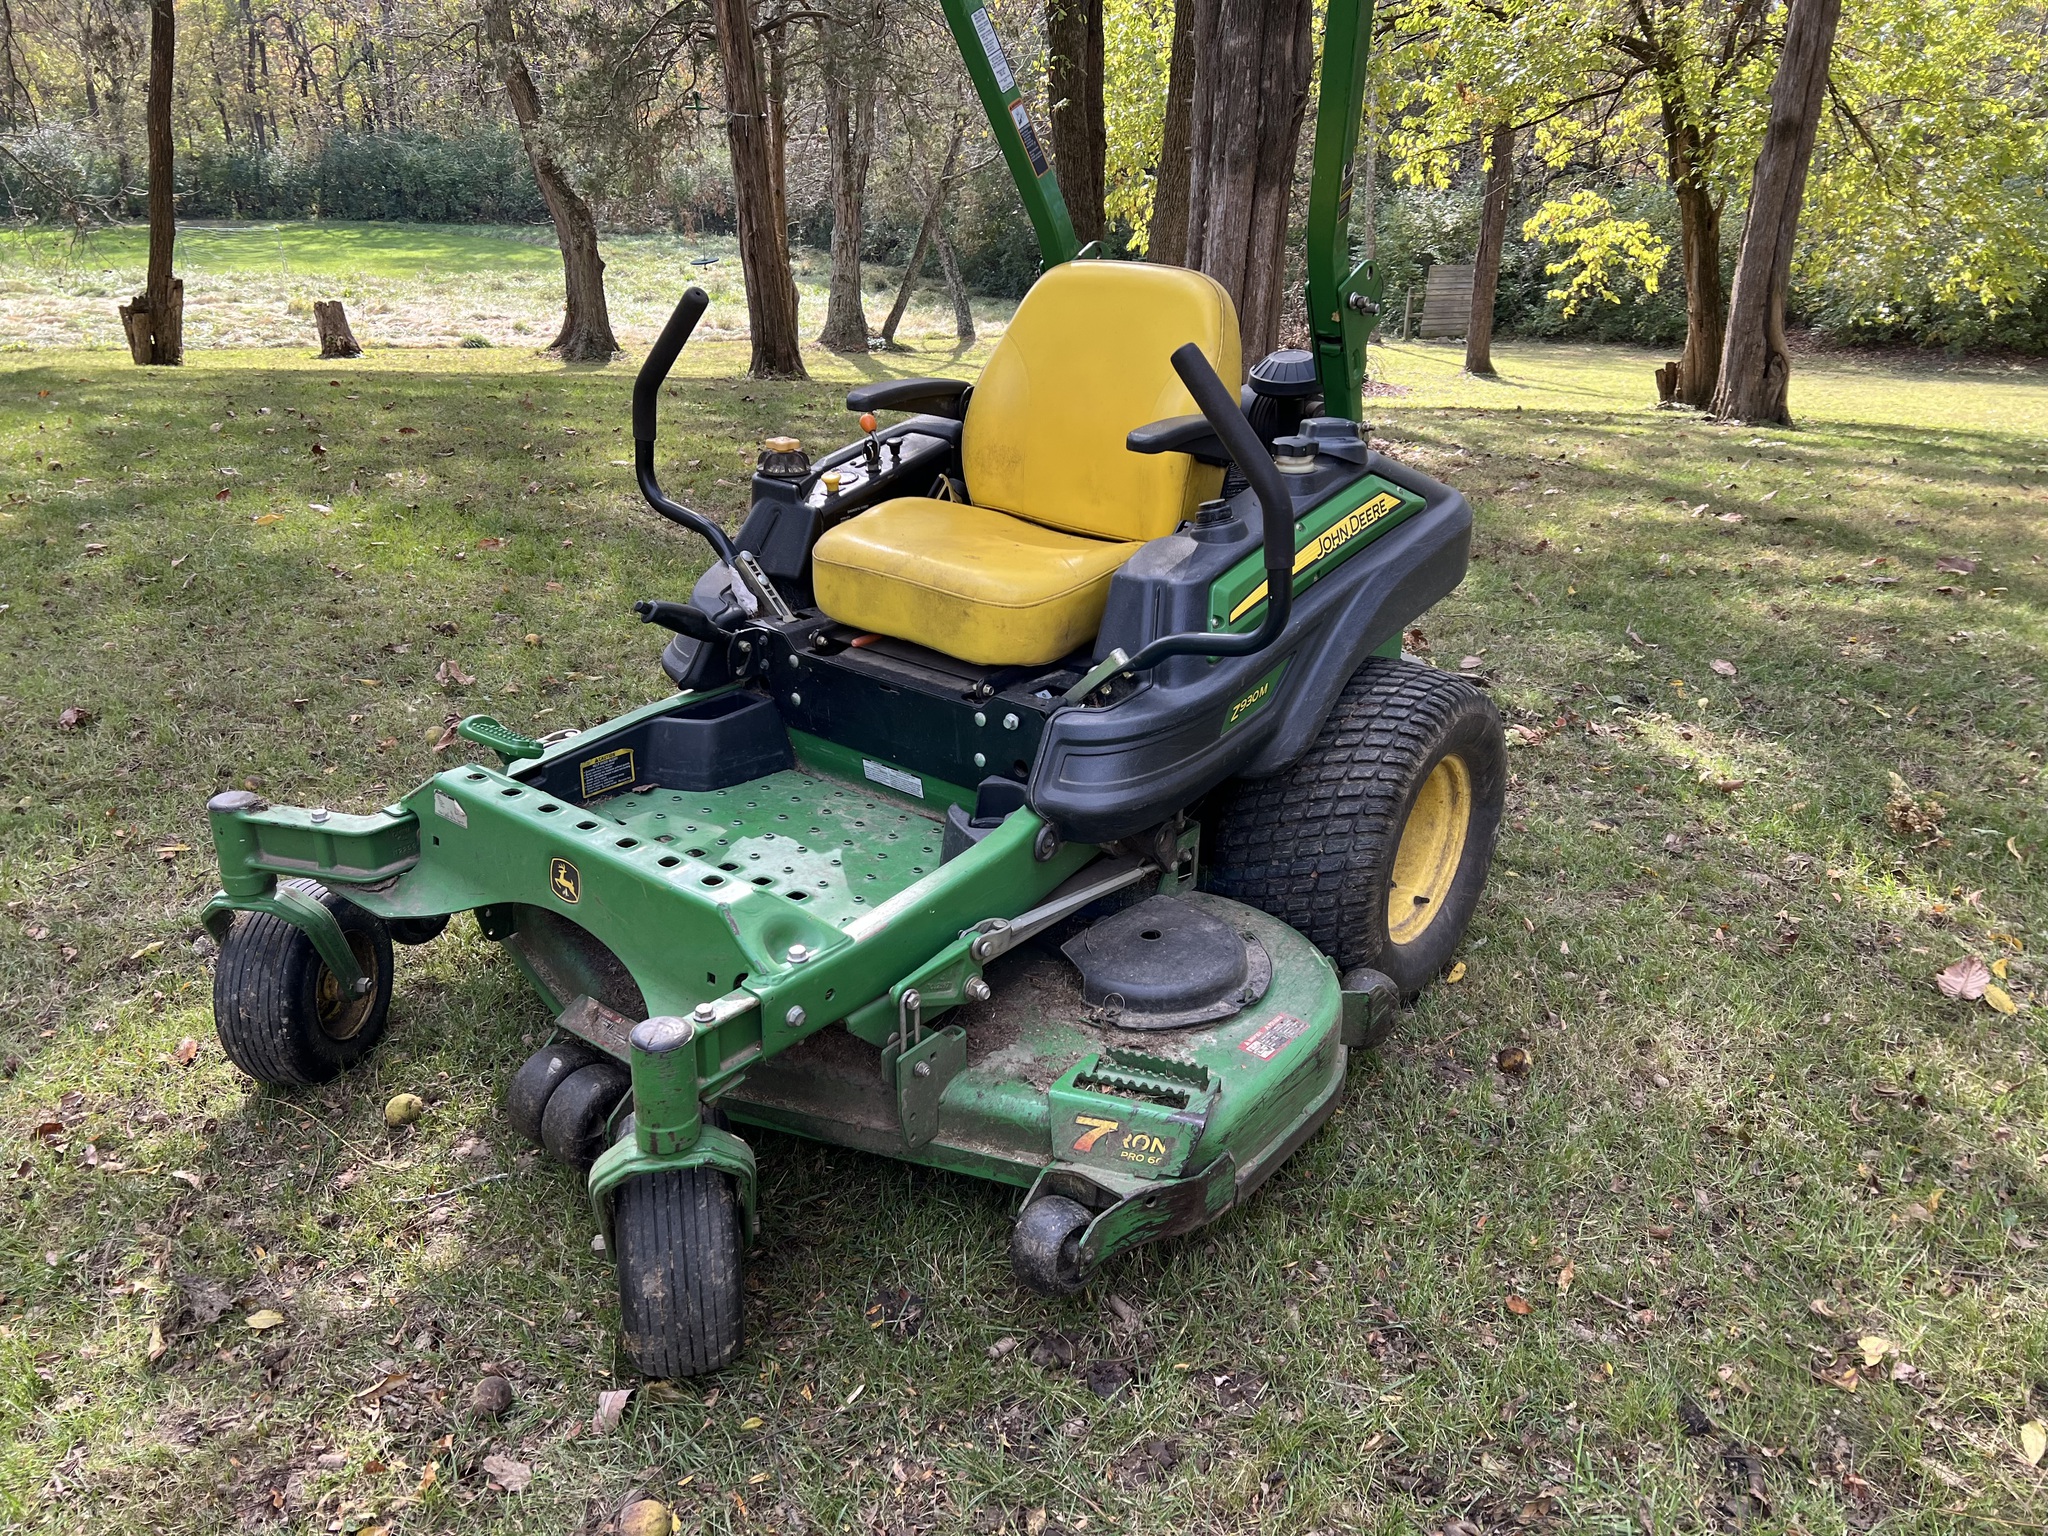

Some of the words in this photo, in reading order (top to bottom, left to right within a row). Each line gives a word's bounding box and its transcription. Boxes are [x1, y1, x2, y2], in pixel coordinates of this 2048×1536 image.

[1317, 522, 1351, 559] JOHN
[1349, 498, 1388, 535] DEERE
[1230, 682, 1269, 722] Z930M
[1073, 1115, 1119, 1153] 7
[1120, 1151, 1145, 1163] PRO
